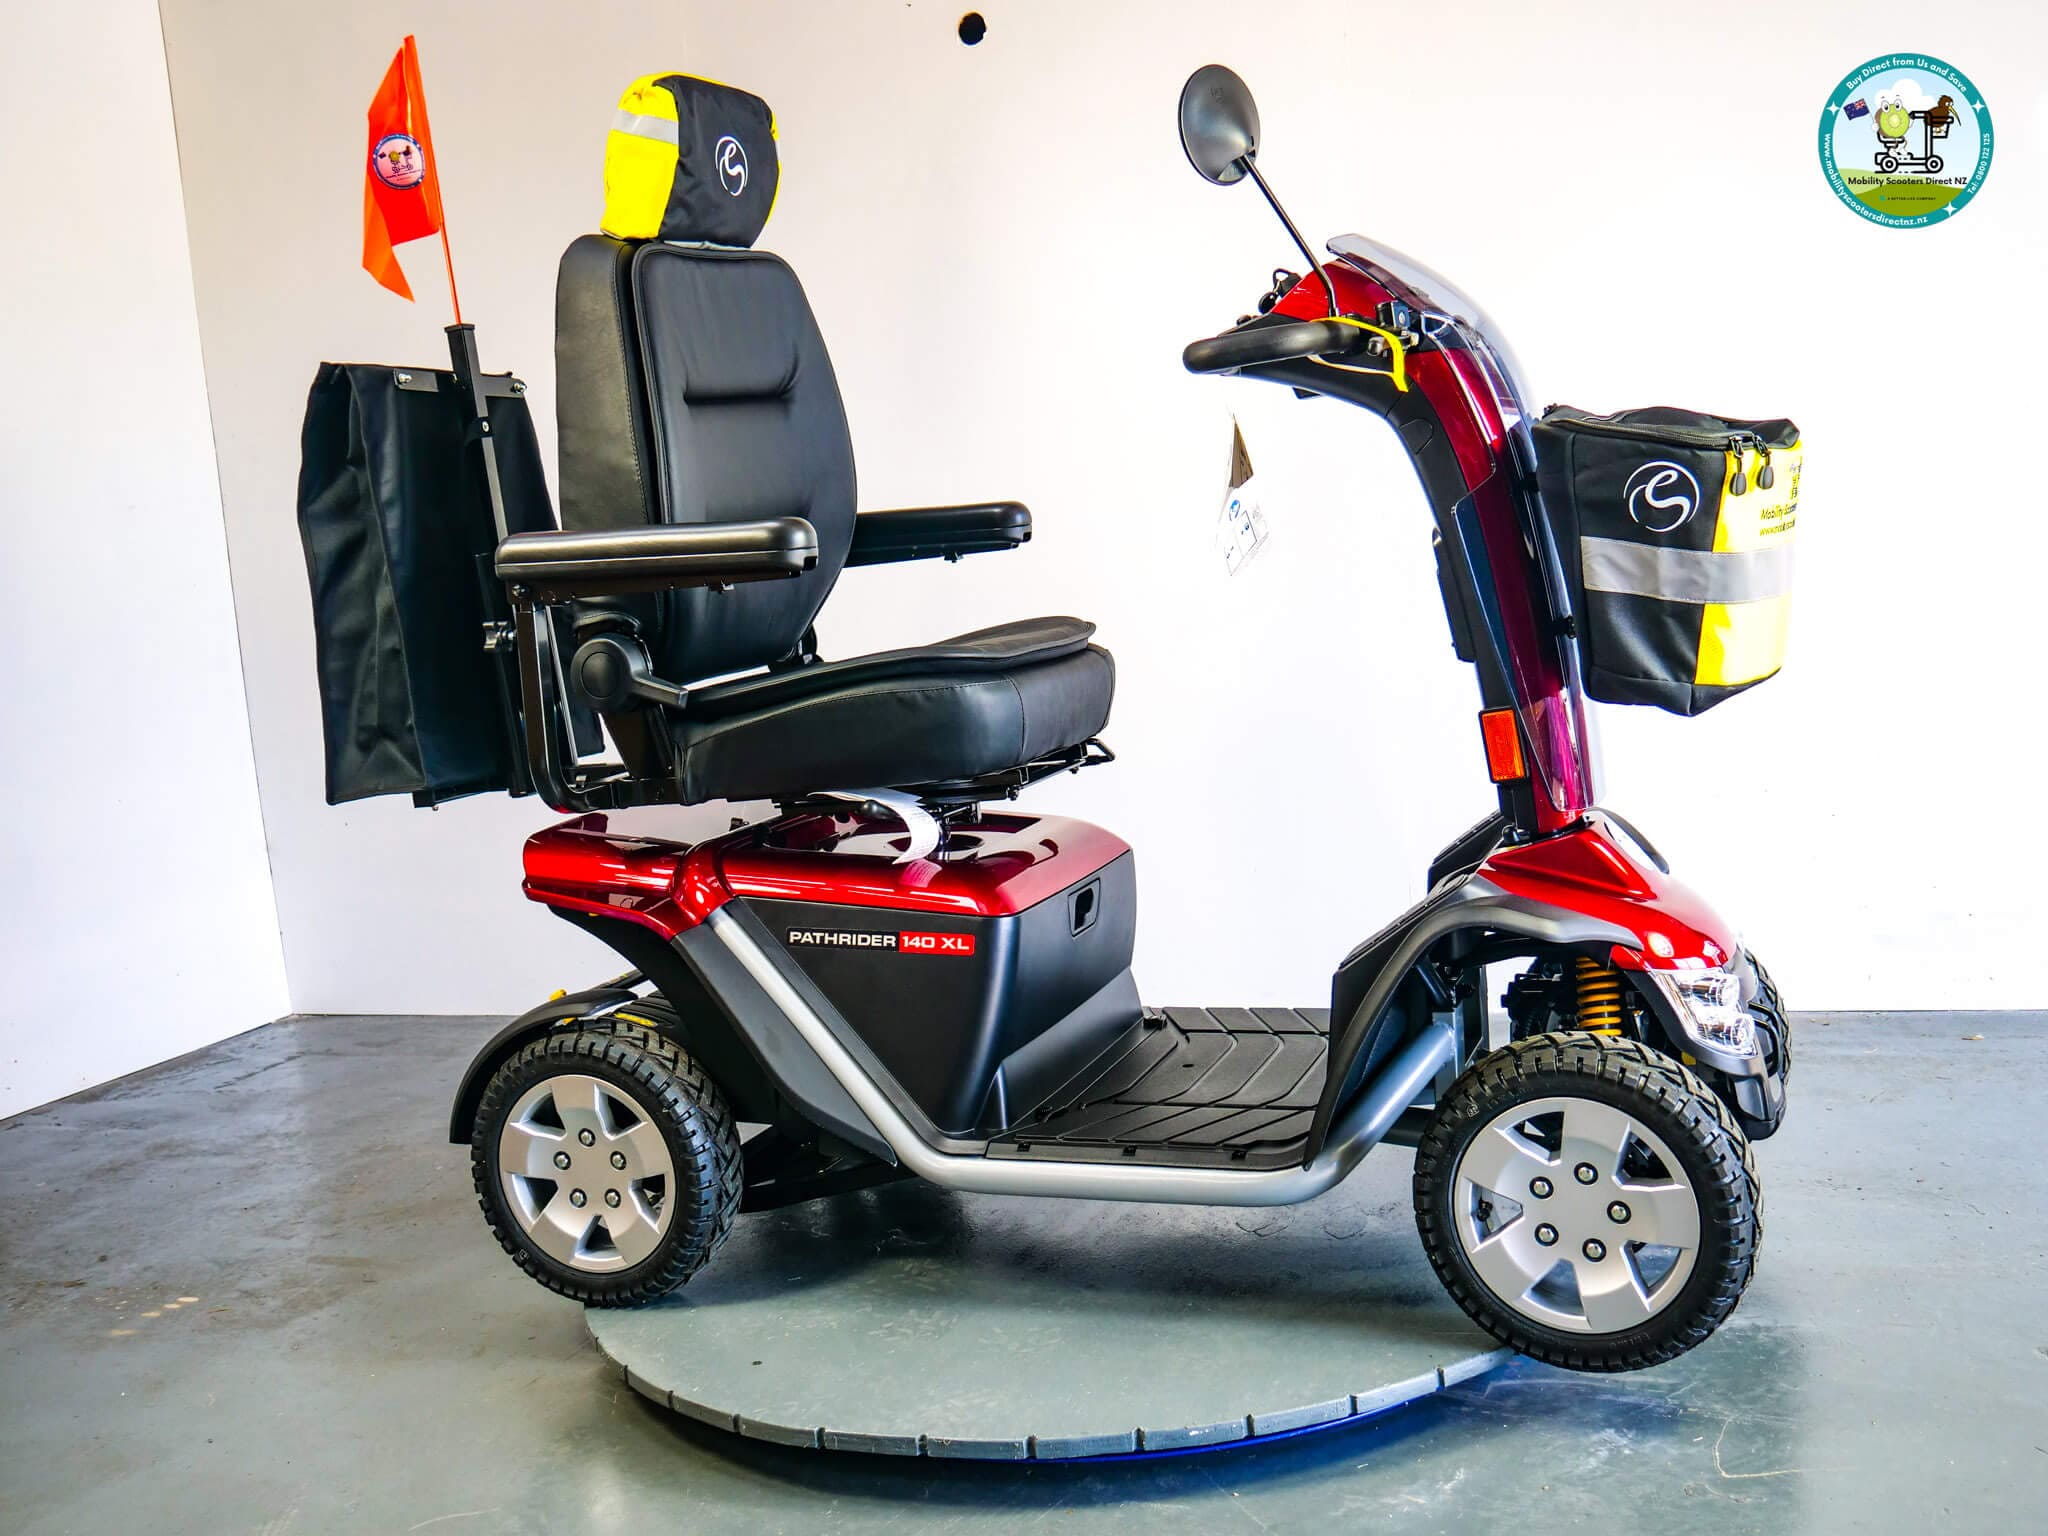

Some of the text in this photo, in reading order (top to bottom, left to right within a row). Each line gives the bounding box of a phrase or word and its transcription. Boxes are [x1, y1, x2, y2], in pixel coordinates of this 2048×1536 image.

[789, 931, 970, 950] PATHRIDER 140 XL
